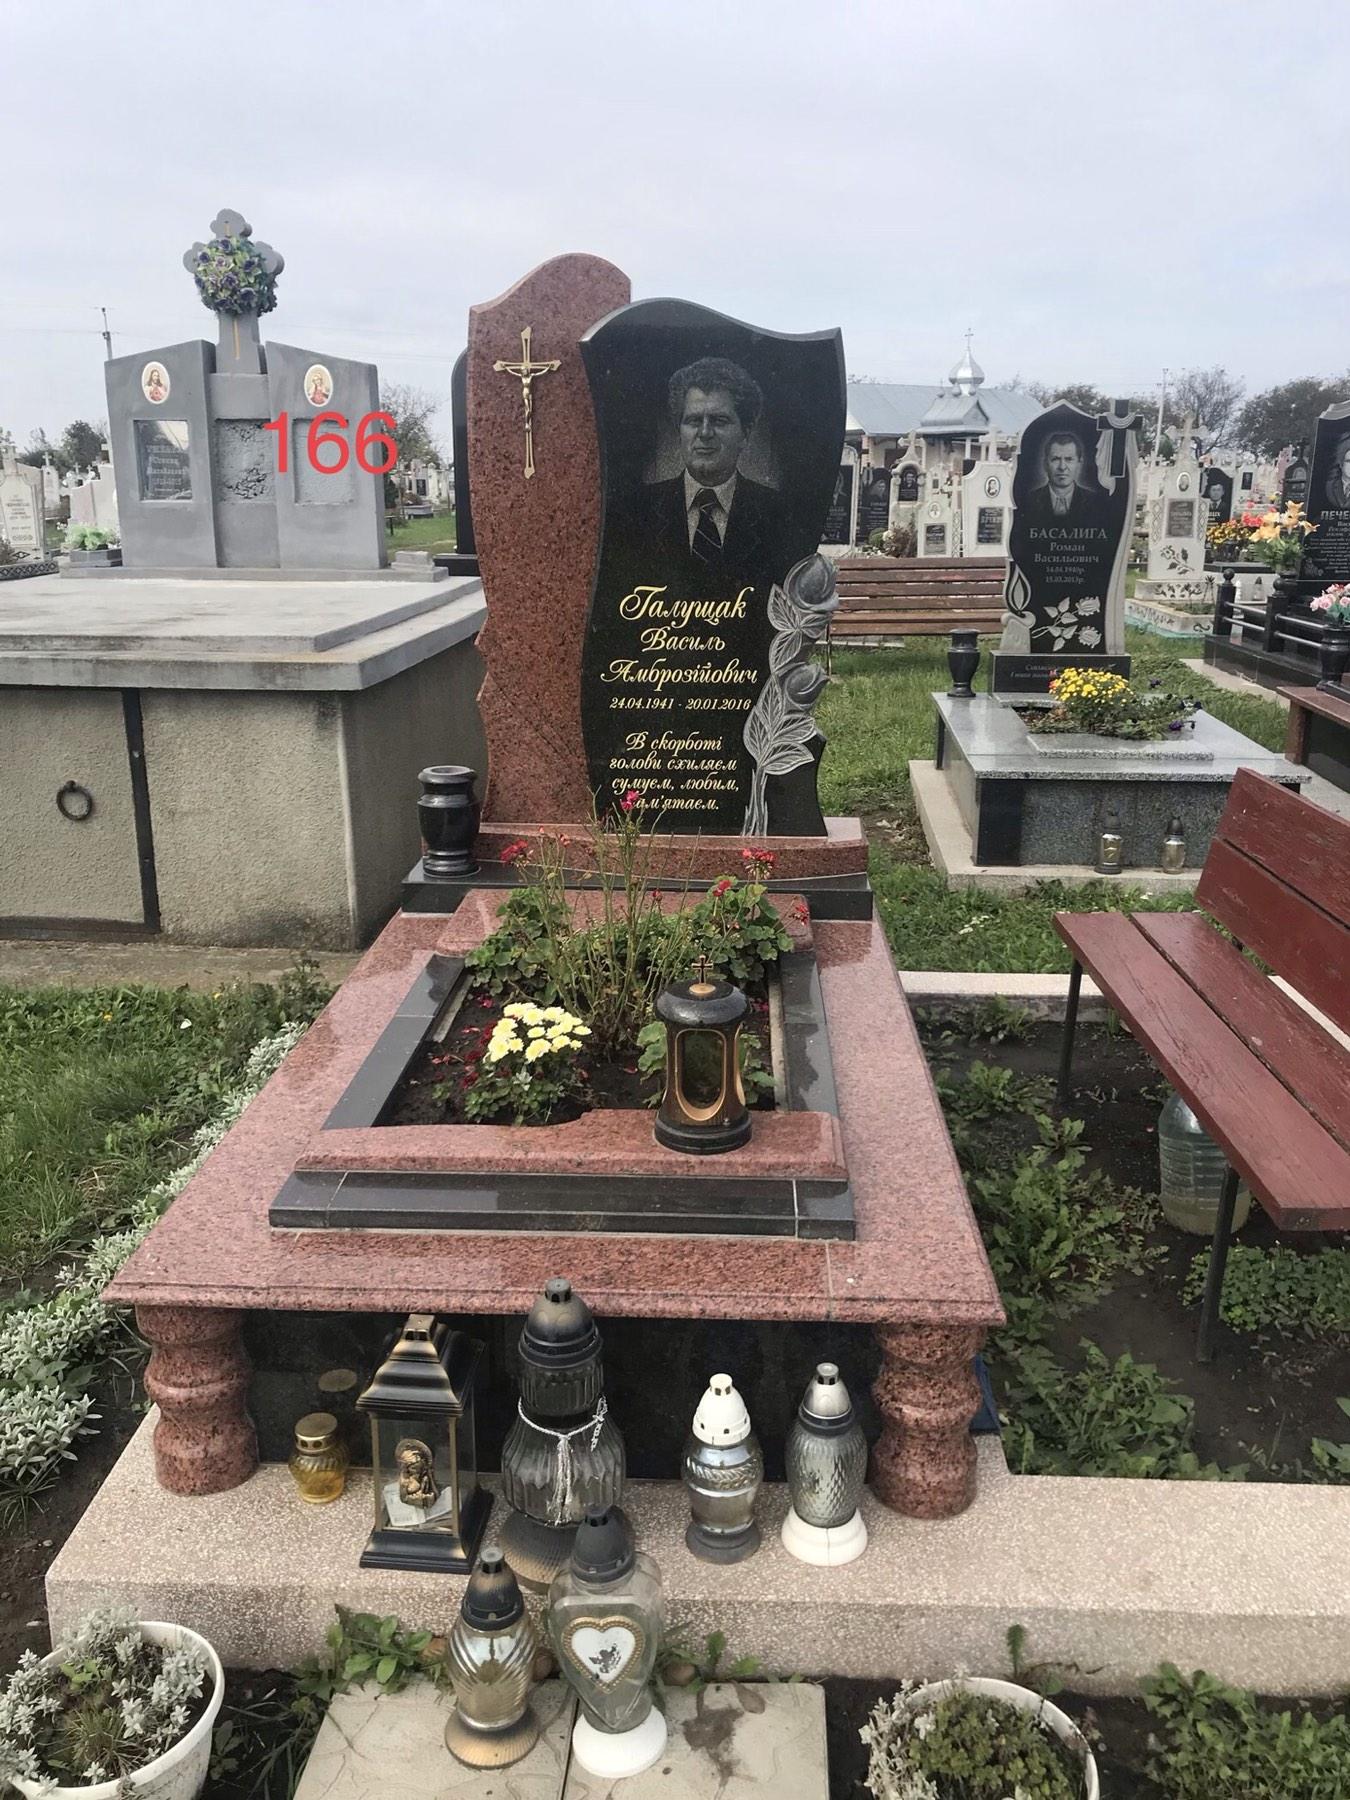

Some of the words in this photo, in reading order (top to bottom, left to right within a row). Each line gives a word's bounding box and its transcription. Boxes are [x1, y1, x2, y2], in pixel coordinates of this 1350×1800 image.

[1029, 527, 1108, 540] БАСАЛИГА
[1050, 542, 1085, 551] Роман
[1034, 553, 1099, 563] Васильович
[619, 585, 755, 628] Галущак
[640, 626, 726, 652] Василь
[600, 658, 758, 691] Амброзійович
[609, 697, 675, 710] 24.04.1941
[685, 698, 752, 711] 20.01.2016
[625, 731, 649, 751] В
[650, 731, 723, 757] скорботі
[609, 750, 662, 770] голови
[667, 758, 737, 771] схиляєм
[611, 777, 675, 796] сумуєм,
[680, 771, 740, 793] любим,
[624, 794, 720, 810] ам'ятаєм.
